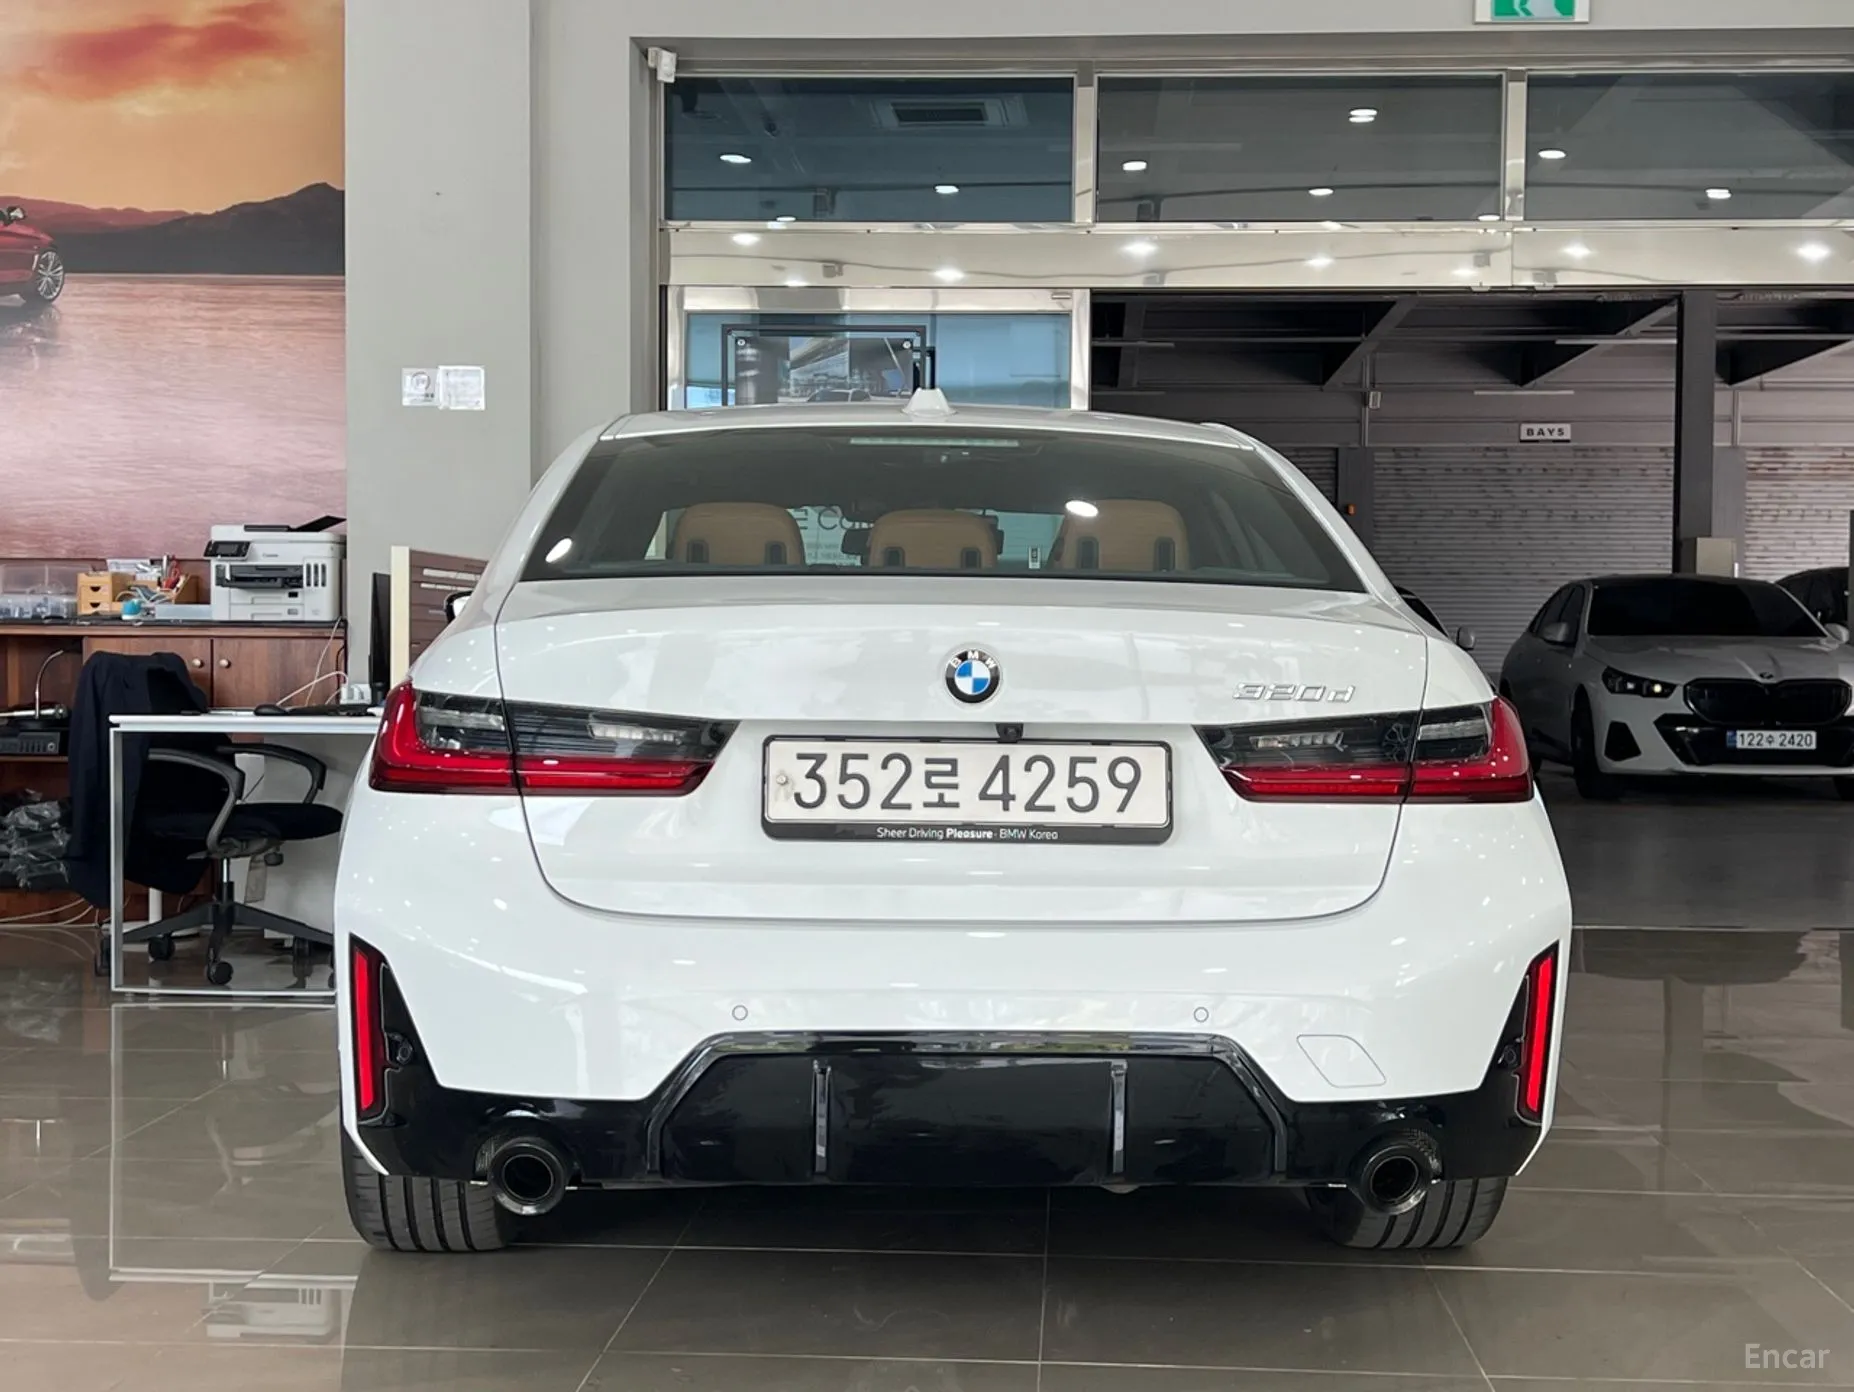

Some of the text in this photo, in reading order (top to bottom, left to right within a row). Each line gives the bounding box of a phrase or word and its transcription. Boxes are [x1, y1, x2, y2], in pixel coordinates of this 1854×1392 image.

[950, 650, 997, 669] BMW
[1233, 682, 1356, 703] 320d
[1778, 733, 1814, 748] 2420
[794, 752, 1142, 813] 352로 4259
[876, 826, 1059, 841] Sheer Driving Pleasure BMW Korea
